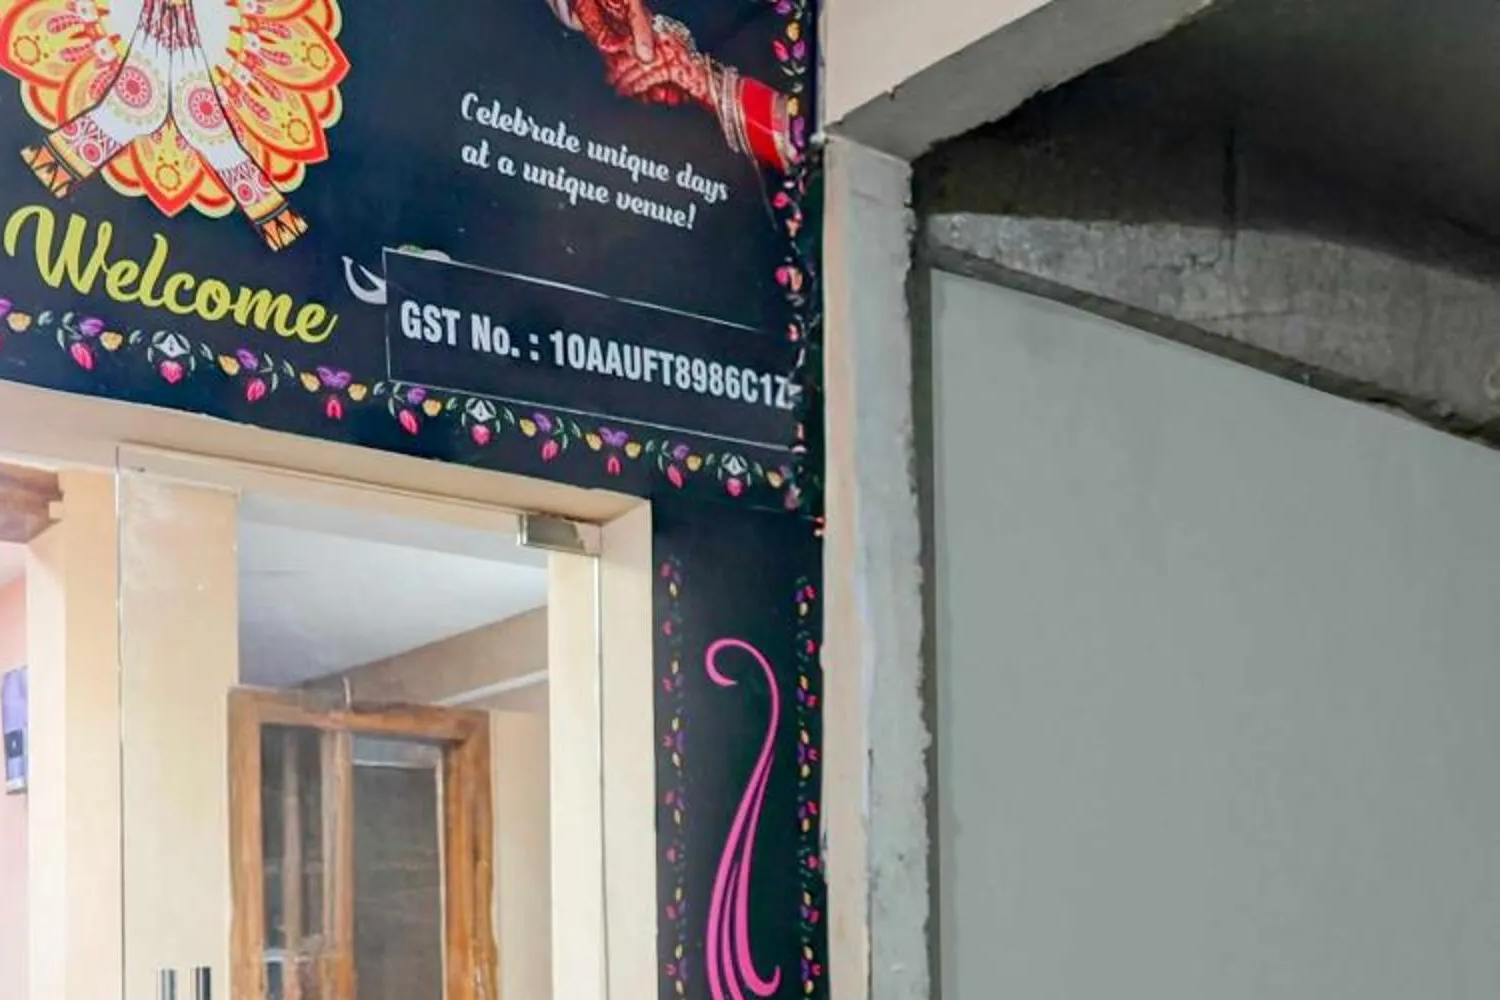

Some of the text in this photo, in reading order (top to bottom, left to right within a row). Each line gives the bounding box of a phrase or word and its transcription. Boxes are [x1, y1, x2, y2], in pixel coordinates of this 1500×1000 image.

[461, 91, 730, 204] Celebrate unique days
[461, 139, 697, 231] at a unique venue!
[3, 204, 339, 343] Welcome
[400, 299, 460, 346] GST
[471, 315, 521, 358] No.
[549, 330, 800, 411] 10AAUFT8986C1Z
